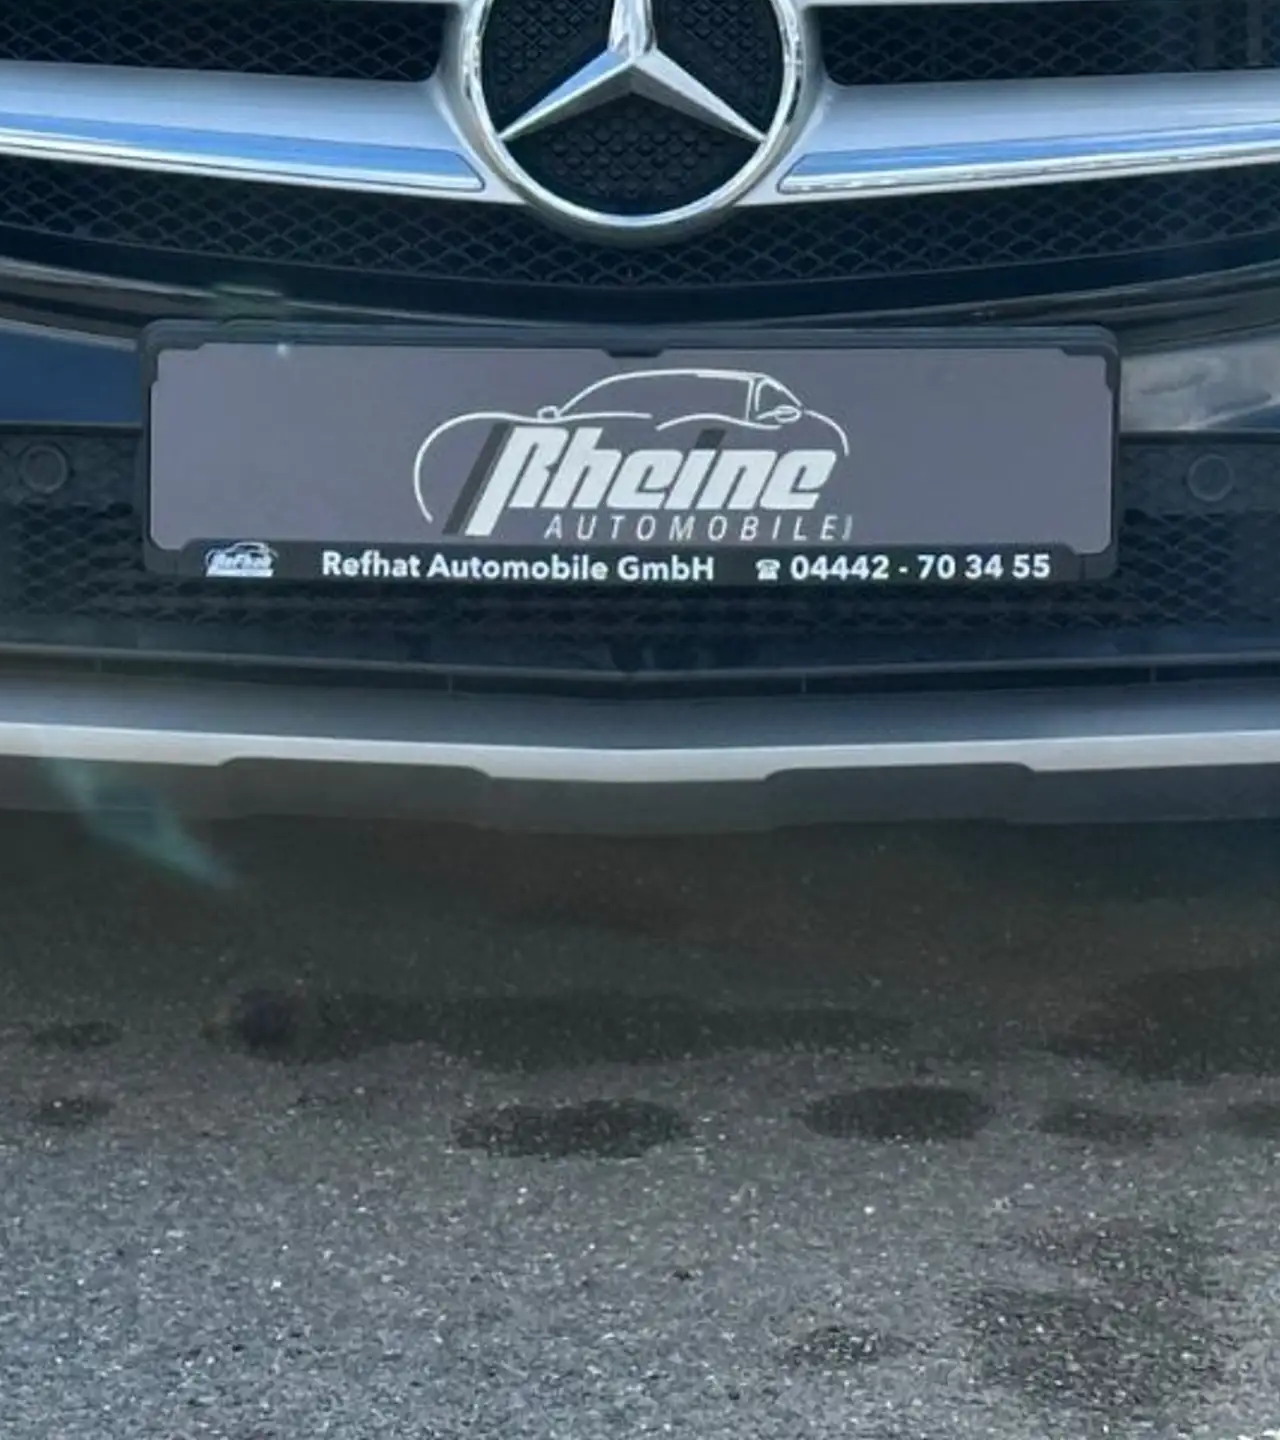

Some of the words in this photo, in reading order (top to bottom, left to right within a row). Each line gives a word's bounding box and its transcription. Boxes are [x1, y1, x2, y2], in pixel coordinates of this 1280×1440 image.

[462, 425, 838, 537] Rheine
[322, 550, 420, 578] Refhat
[426, 552, 608, 581] Automobile
[618, 554, 715, 581] GmbH
[789, 554, 890, 581] 04442
[917, 554, 957, 580] 70
[964, 554, 1004, 580] 34
[1011, 553, 1051, 579] 55
